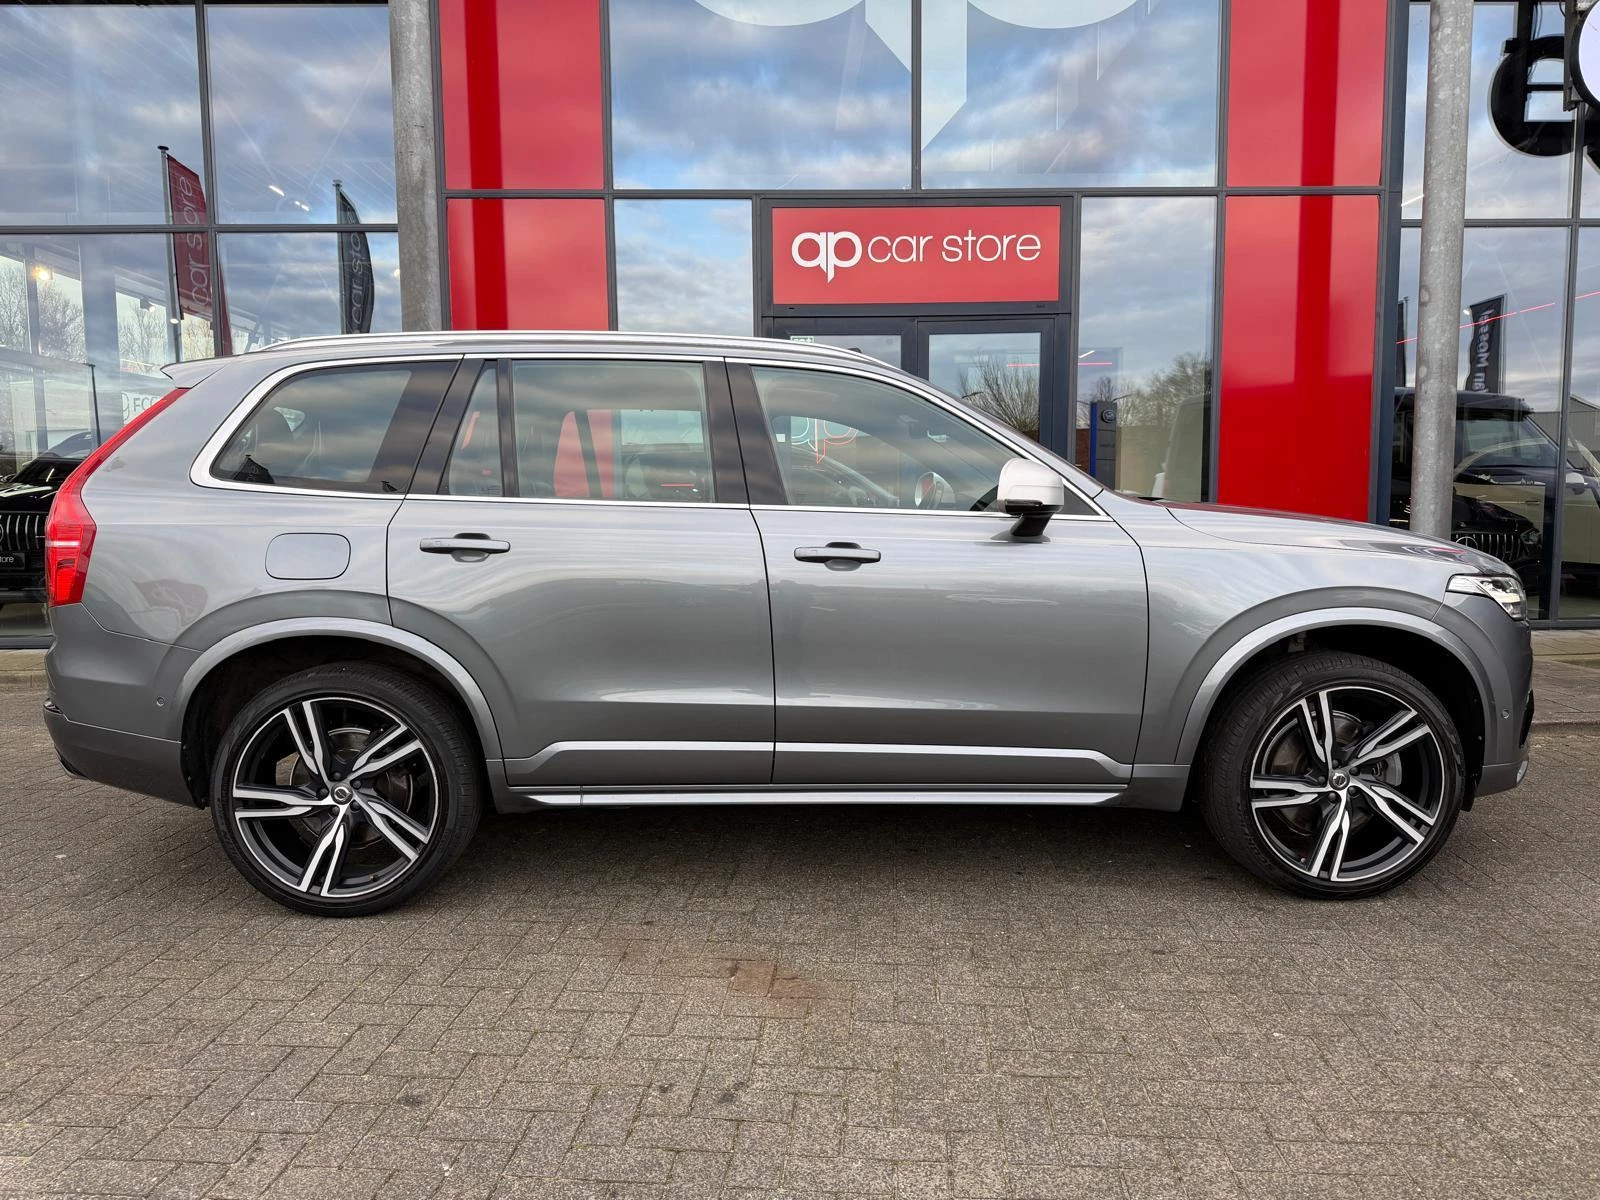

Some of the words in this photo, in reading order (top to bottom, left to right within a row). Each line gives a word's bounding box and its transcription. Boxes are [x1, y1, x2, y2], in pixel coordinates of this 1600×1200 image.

[178, 175, 203, 249] sore
[187, 254, 212, 305] car
[791, 231, 863, 284] ap
[867, 235, 934, 263] car
[941, 229, 1042, 262] store
[351, 280, 363, 324] car
